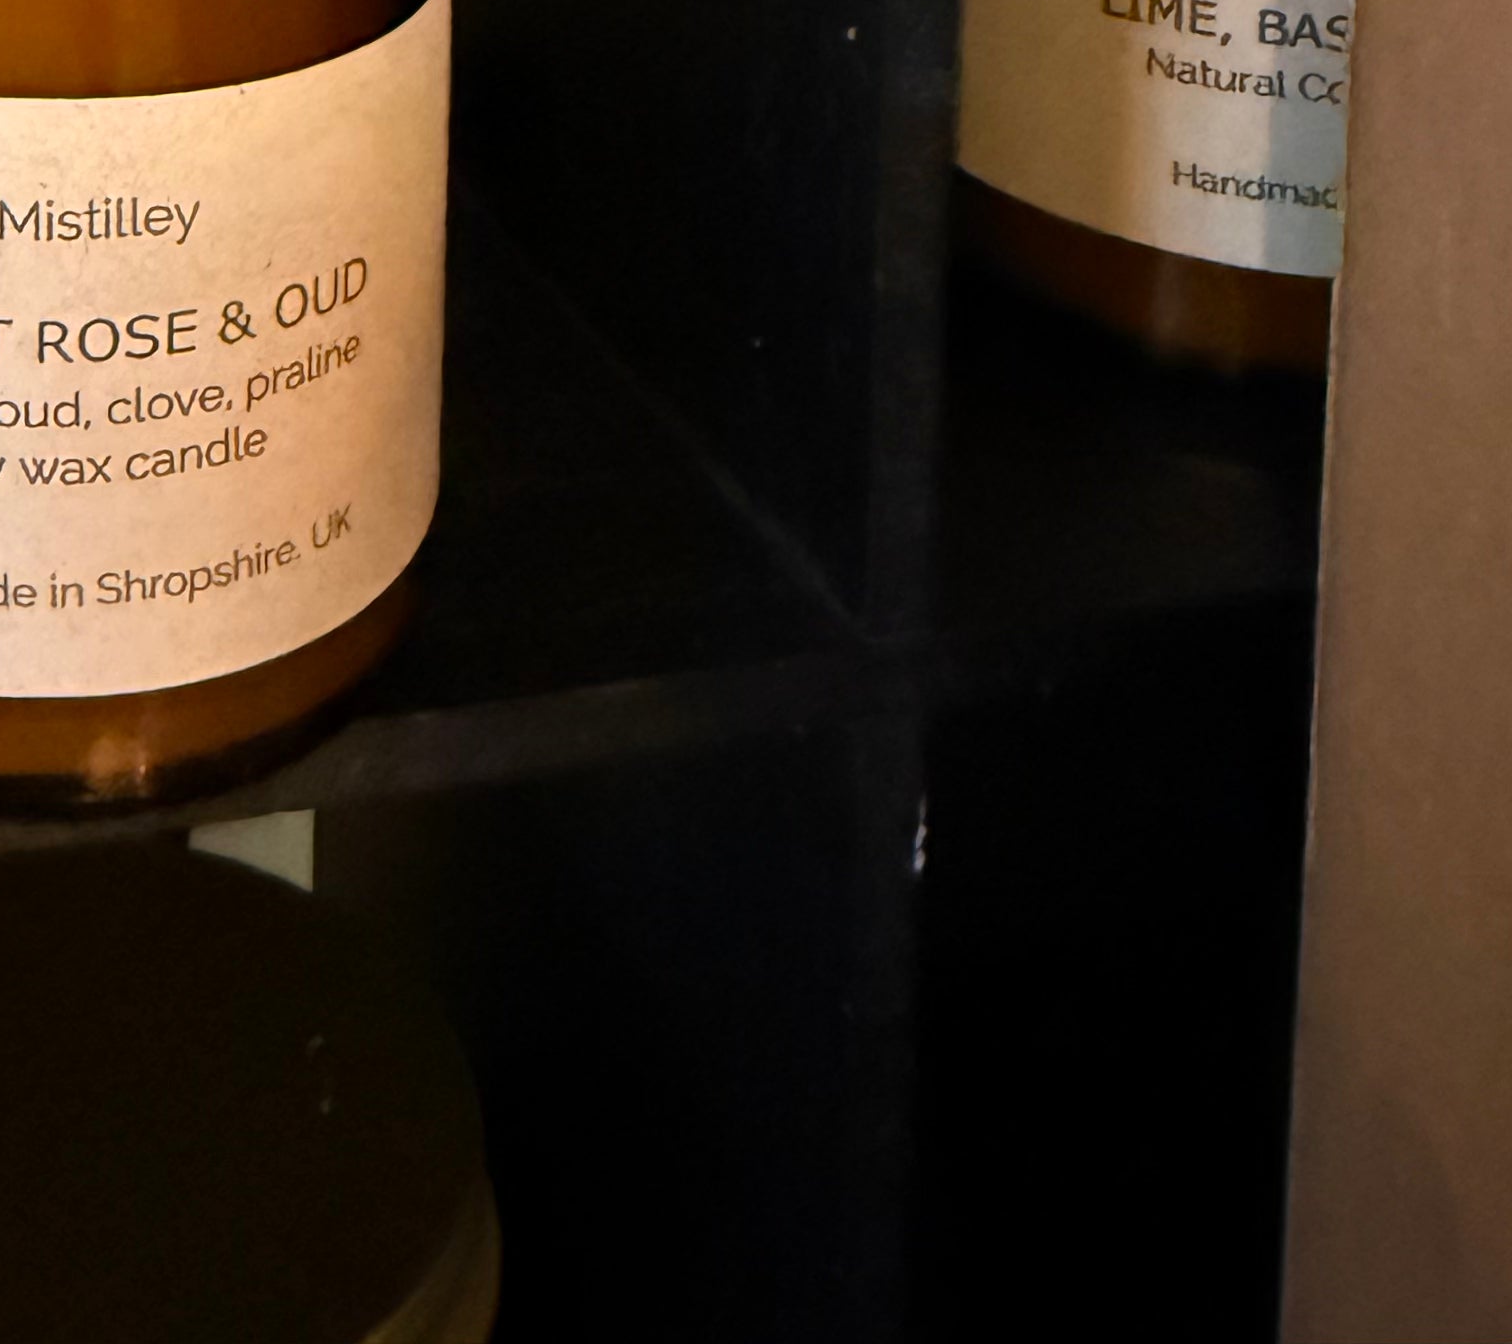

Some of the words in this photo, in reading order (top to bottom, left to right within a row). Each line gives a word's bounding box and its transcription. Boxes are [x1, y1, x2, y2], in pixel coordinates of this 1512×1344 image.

[1146, 47, 1286, 99] Natural
[37, 308, 199, 364] ROSE
[219, 299, 258, 345] &
[275, 257, 369, 328] OUD
[107, 388, 233, 426] clove,
[245, 333, 361, 411] praline
[19, 453, 112, 485] wax
[126, 426, 269, 480] candle
[50, 573, 84, 609] in
[312, 503, 353, 549] UK
